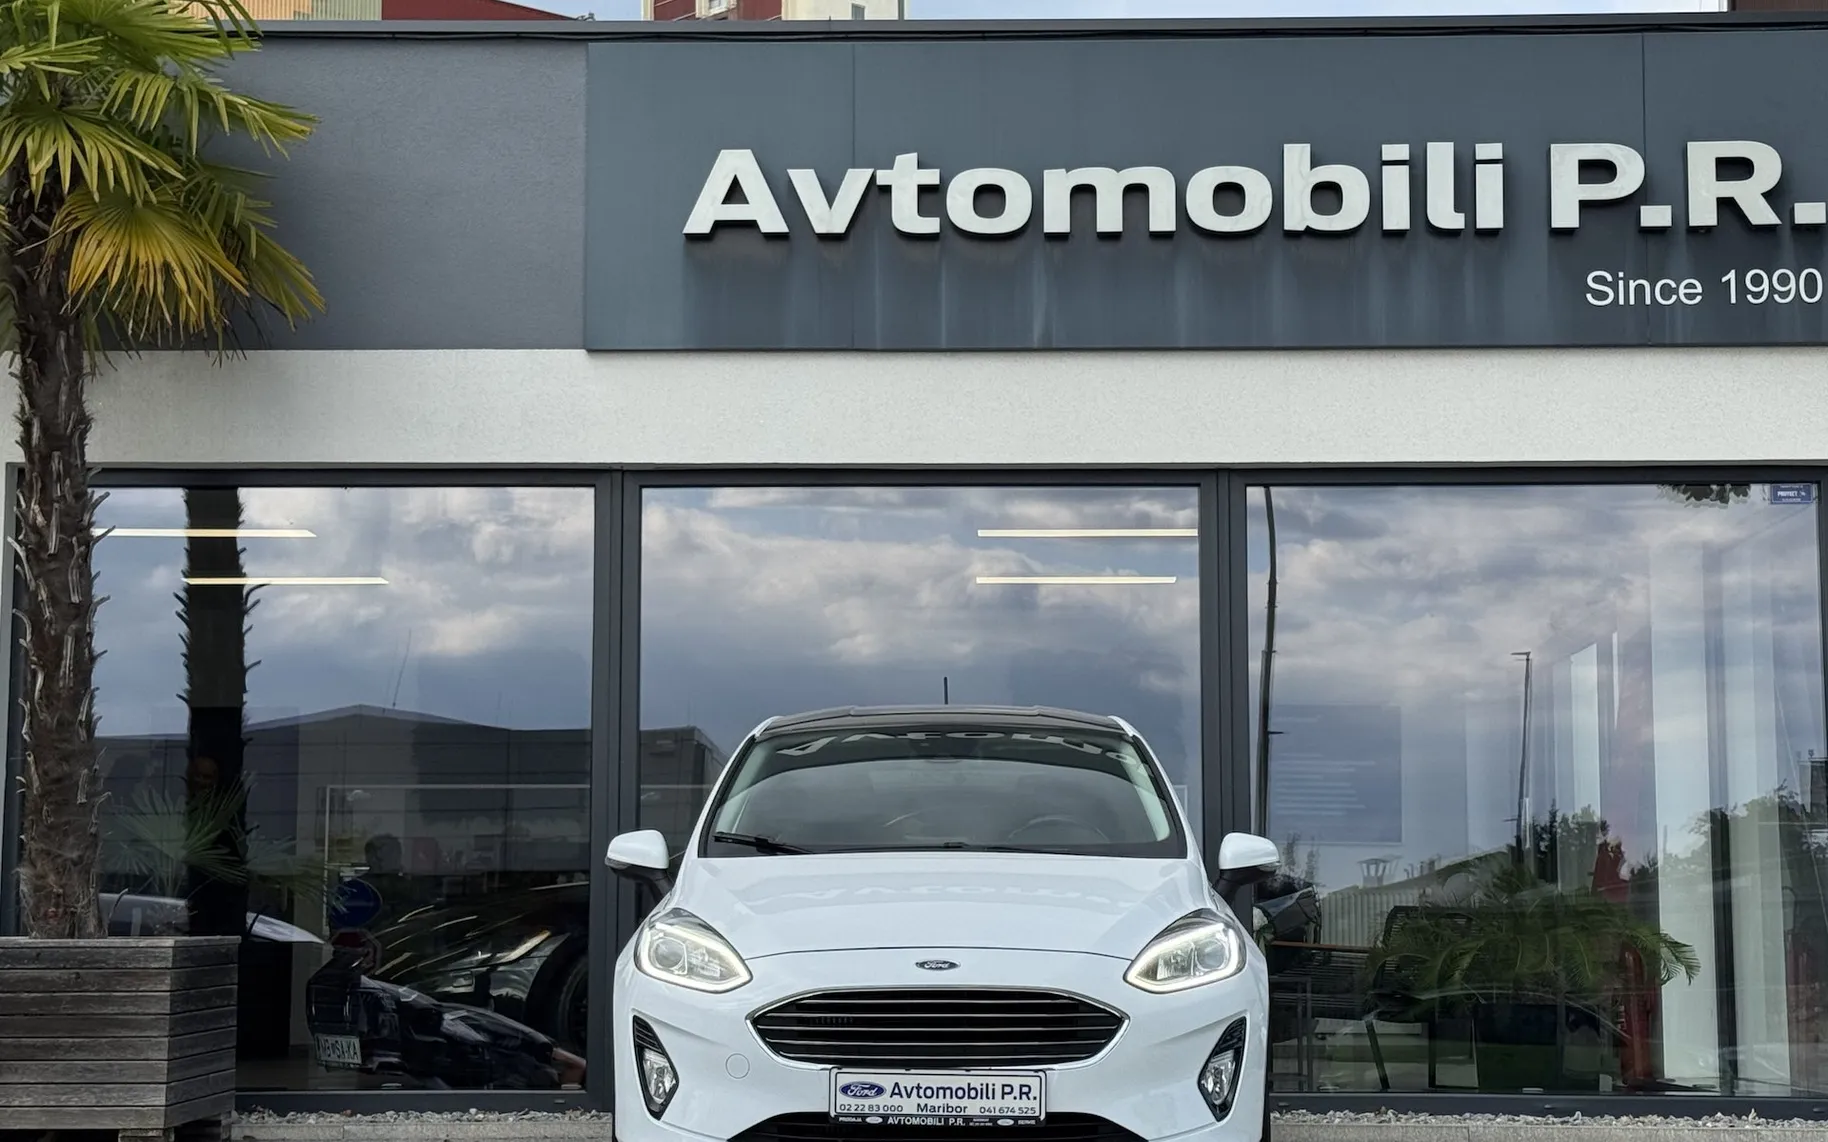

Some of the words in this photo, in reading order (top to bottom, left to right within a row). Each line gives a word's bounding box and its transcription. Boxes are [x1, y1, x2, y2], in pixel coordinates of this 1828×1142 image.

[683, 142, 1504, 236] Avtomobili
[1549, 140, 1827, 230] P.R.
[1585, 270, 1703, 306] Since
[1720, 267, 1824, 305] 1990
[889, 1082, 996, 1100] Avtomobili
[1001, 1083, 1037, 1101] P.R.
[916, 1102, 968, 1114] Maribor
[1018, 1106, 1037, 1115] 525
[887, 1116, 945, 1126] AVTOMOBILI
[948, 1117, 966, 1127] P.R.
